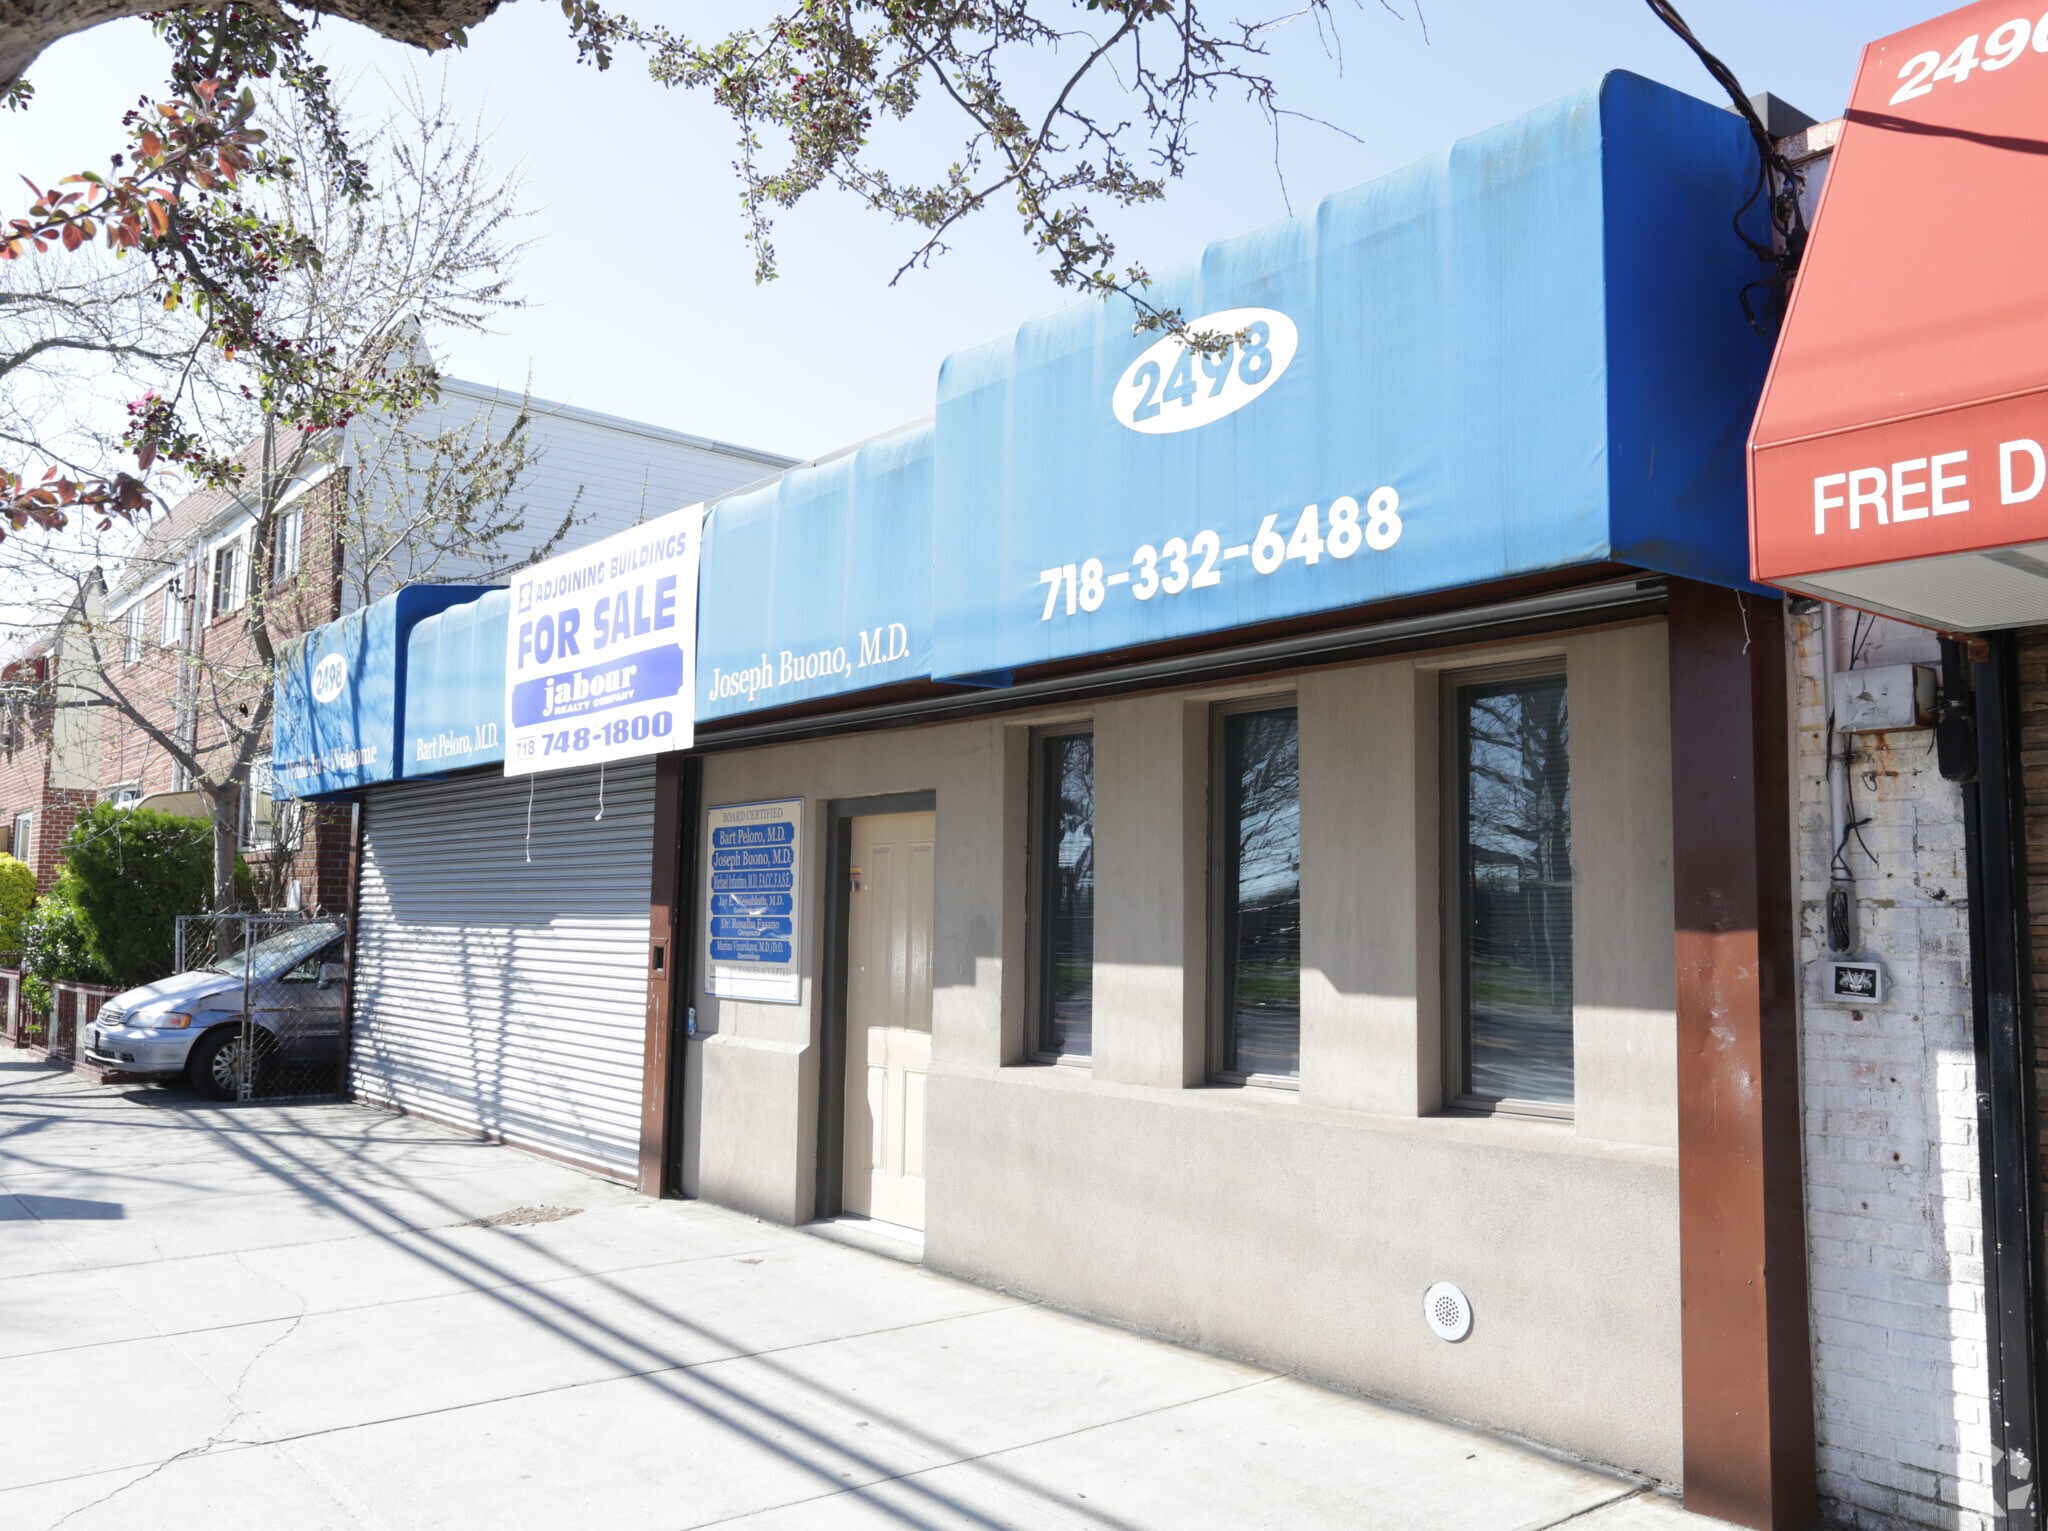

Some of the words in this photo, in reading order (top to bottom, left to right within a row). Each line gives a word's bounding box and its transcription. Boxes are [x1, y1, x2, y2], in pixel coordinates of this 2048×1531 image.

[1132, 320, 1273, 423] 2498
[1814, 449, 1970, 536] FREE
[536, 561, 605, 603] ADJOINING
[610, 531, 687, 579] BUILDINGS
[1039, 485, 1403, 621] 718-332-6488
[517, 607, 580, 670] FOR
[593, 574, 677, 650] SALE
[316, 661, 342, 696] 2498
[709, 653, 773, 702] Joseph
[778, 646, 852, 686] Buono,
[857, 622, 910, 668] M.D.
[542, 664, 638, 717] jabour
[554, 700, 590, 715] REALTY
[593, 689, 635, 708] COMPANY
[416, 738, 437, 761] Bart
[438, 730, 473, 757] Peloro,
[474, 722, 498, 751] M.D.
[517, 740, 535, 758] 718
[542, 711, 673, 756] 748-1800
[330, 743, 378, 771] Welcome
[722, 811, 745, 823] BOARD
[746, 807, 783, 820] CERTIFIED
[719, 830, 736, 845] Bart
[738, 828, 765, 846] Peloro,
[767, 826, 785, 842] M.D.
[713, 850, 740, 870] Joseph
[742, 851, 770, 867] Buono,
[772, 848, 791, 864] M.D.
[718, 897, 729, 908] Jay
[769, 895, 784, 906] M.D.
[721, 918, 731, 929] Dr.
[757, 918, 780, 929] Fasano
